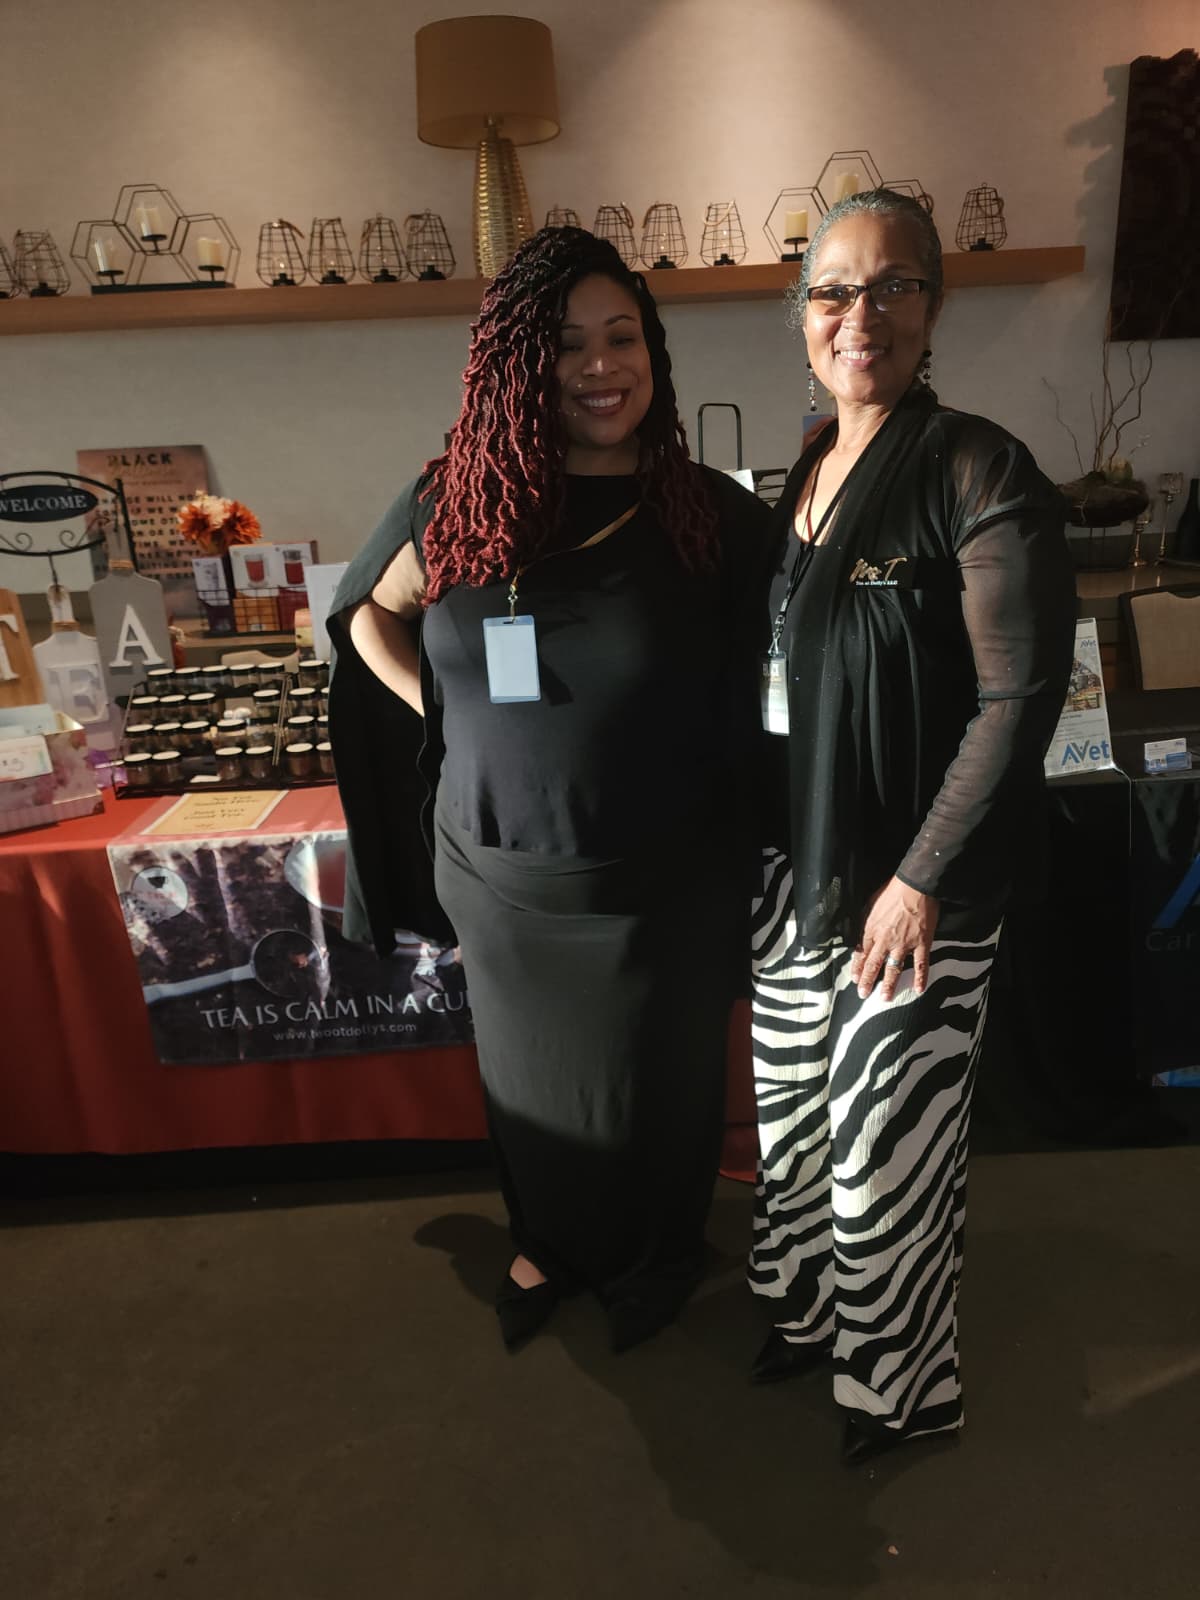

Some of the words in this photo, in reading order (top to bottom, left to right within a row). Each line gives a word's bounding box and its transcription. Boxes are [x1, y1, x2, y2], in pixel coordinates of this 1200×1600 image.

[107, 453, 171, 468] BLACK
[0, 495, 88, 513] WELCOME
[108, 603, 165, 668] A
[1061, 739, 1111, 767] AVet
[200, 1006, 249, 1029] TEA
[255, 1004, 279, 1026] IS
[285, 999, 359, 1023] CALM
[367, 994, 394, 1015] IN
[402, 993, 421, 1015] A
[426, 991, 465, 1014] CU
